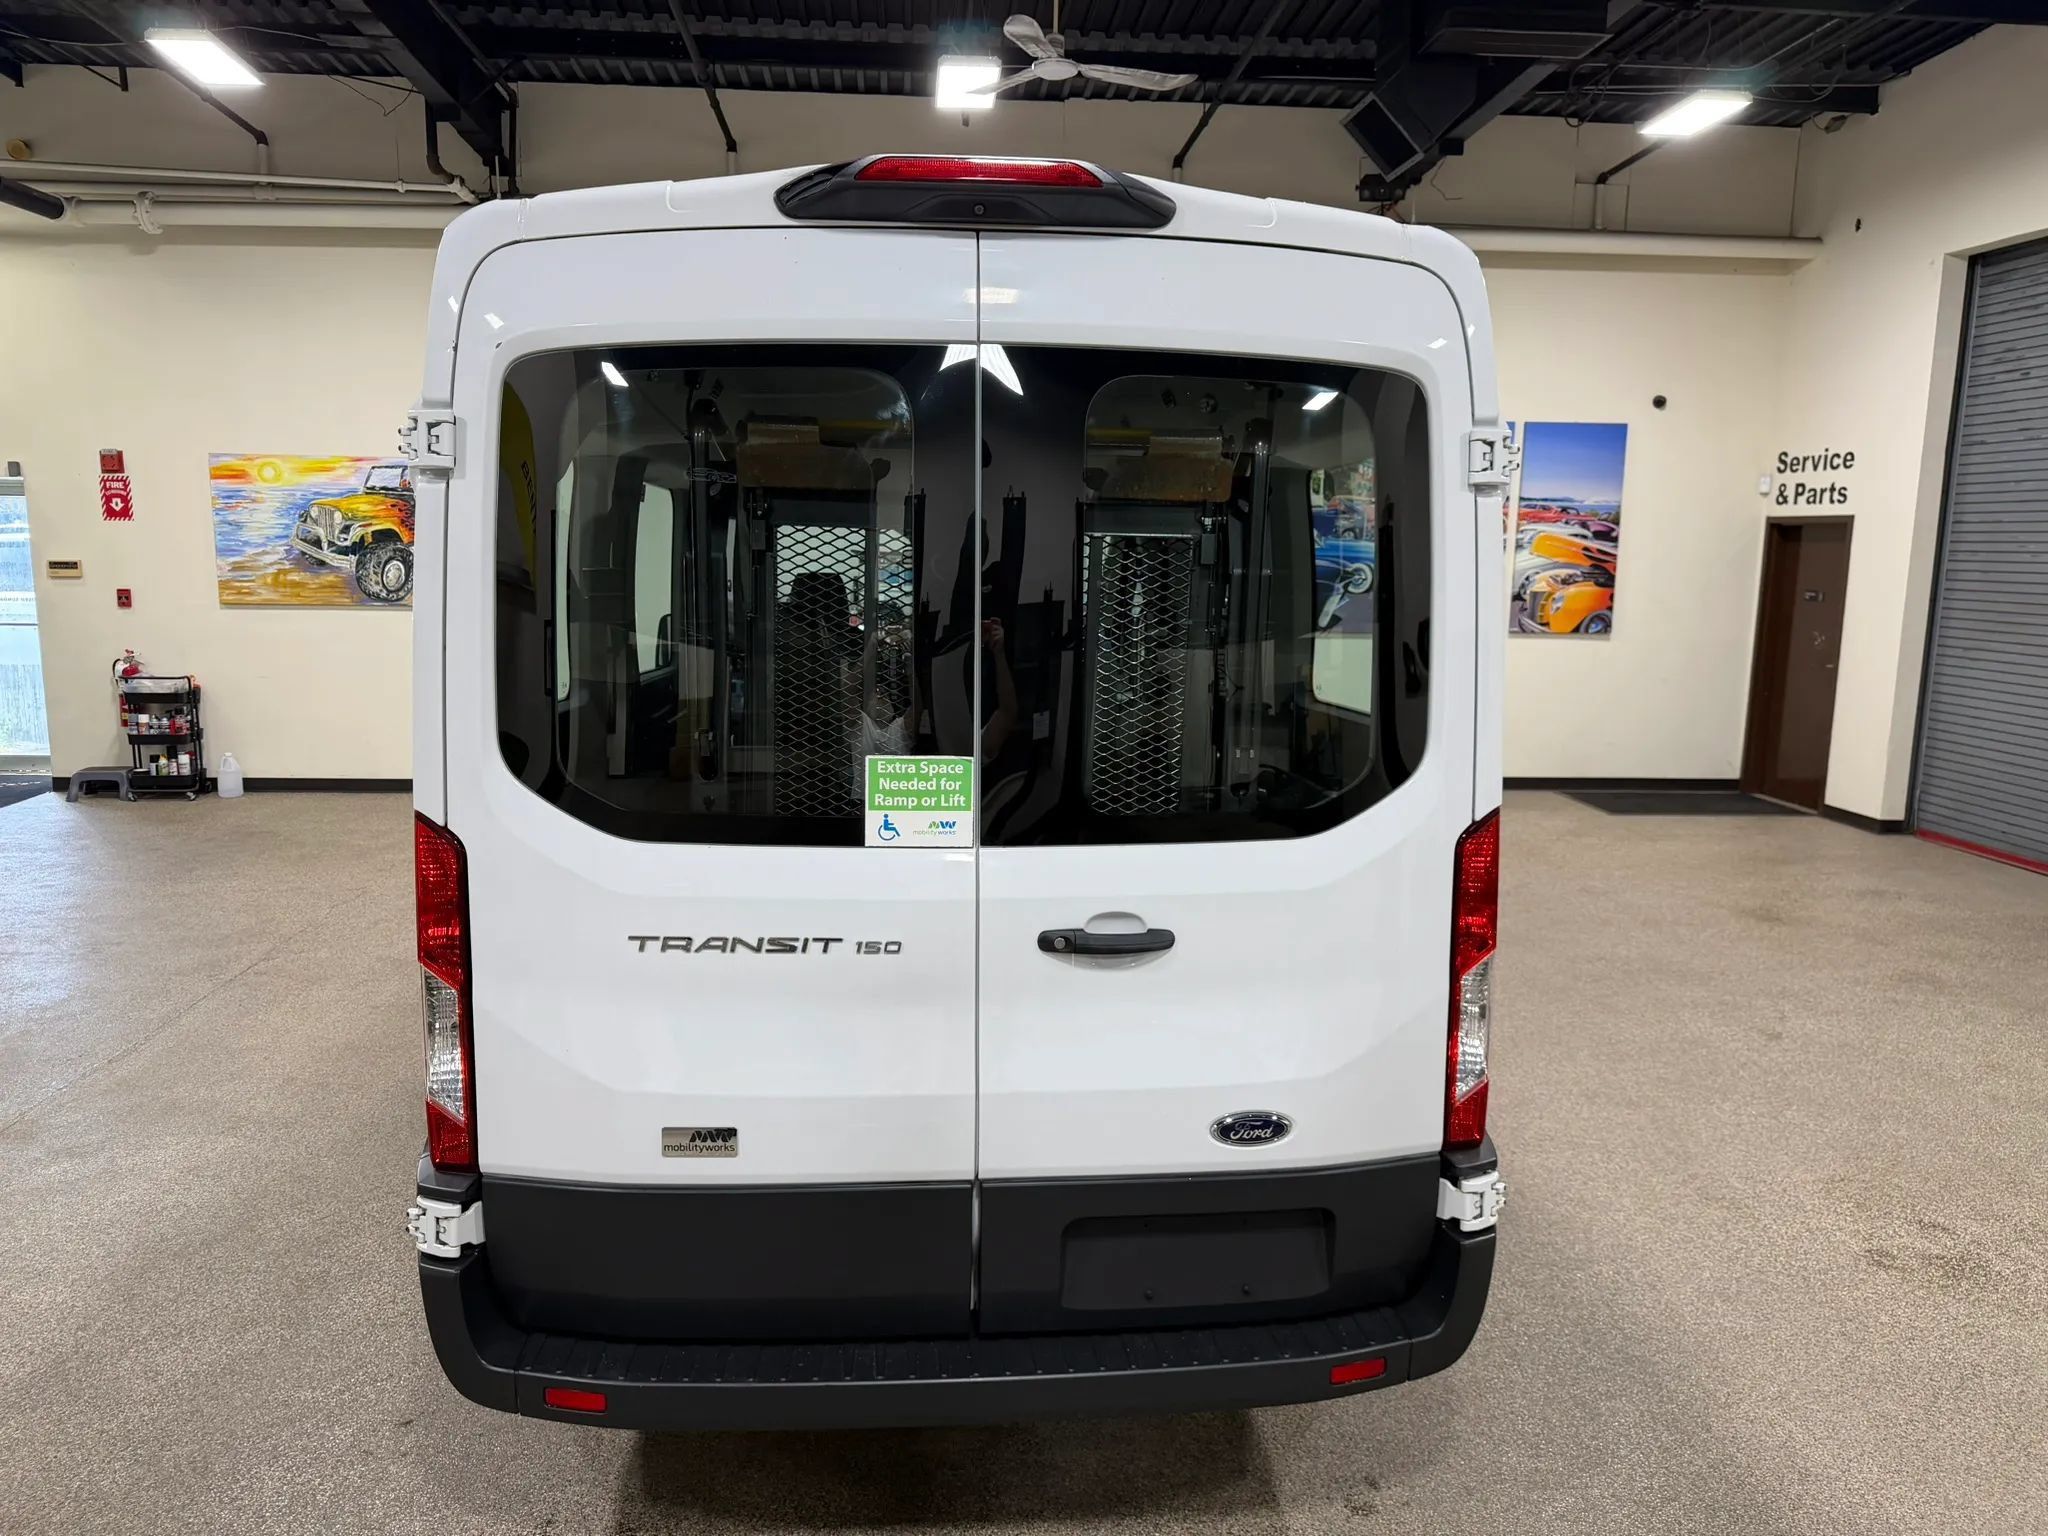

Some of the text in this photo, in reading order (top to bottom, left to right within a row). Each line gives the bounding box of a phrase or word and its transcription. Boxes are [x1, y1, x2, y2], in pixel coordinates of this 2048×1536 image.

[1776, 448, 1855, 474] Service
[105, 481, 125, 489] FIRE
[1775, 481, 1848, 505] & Parts
[877, 760, 964, 776] Extra Space
[879, 777, 962, 791] Needed for
[874, 793, 966, 809] Ramp or Lift
[627, 935, 902, 955] TRANSIT 150
[1230, 1121, 1275, 1139] Ford
[663, 1142, 736, 1154] mobilityworks
